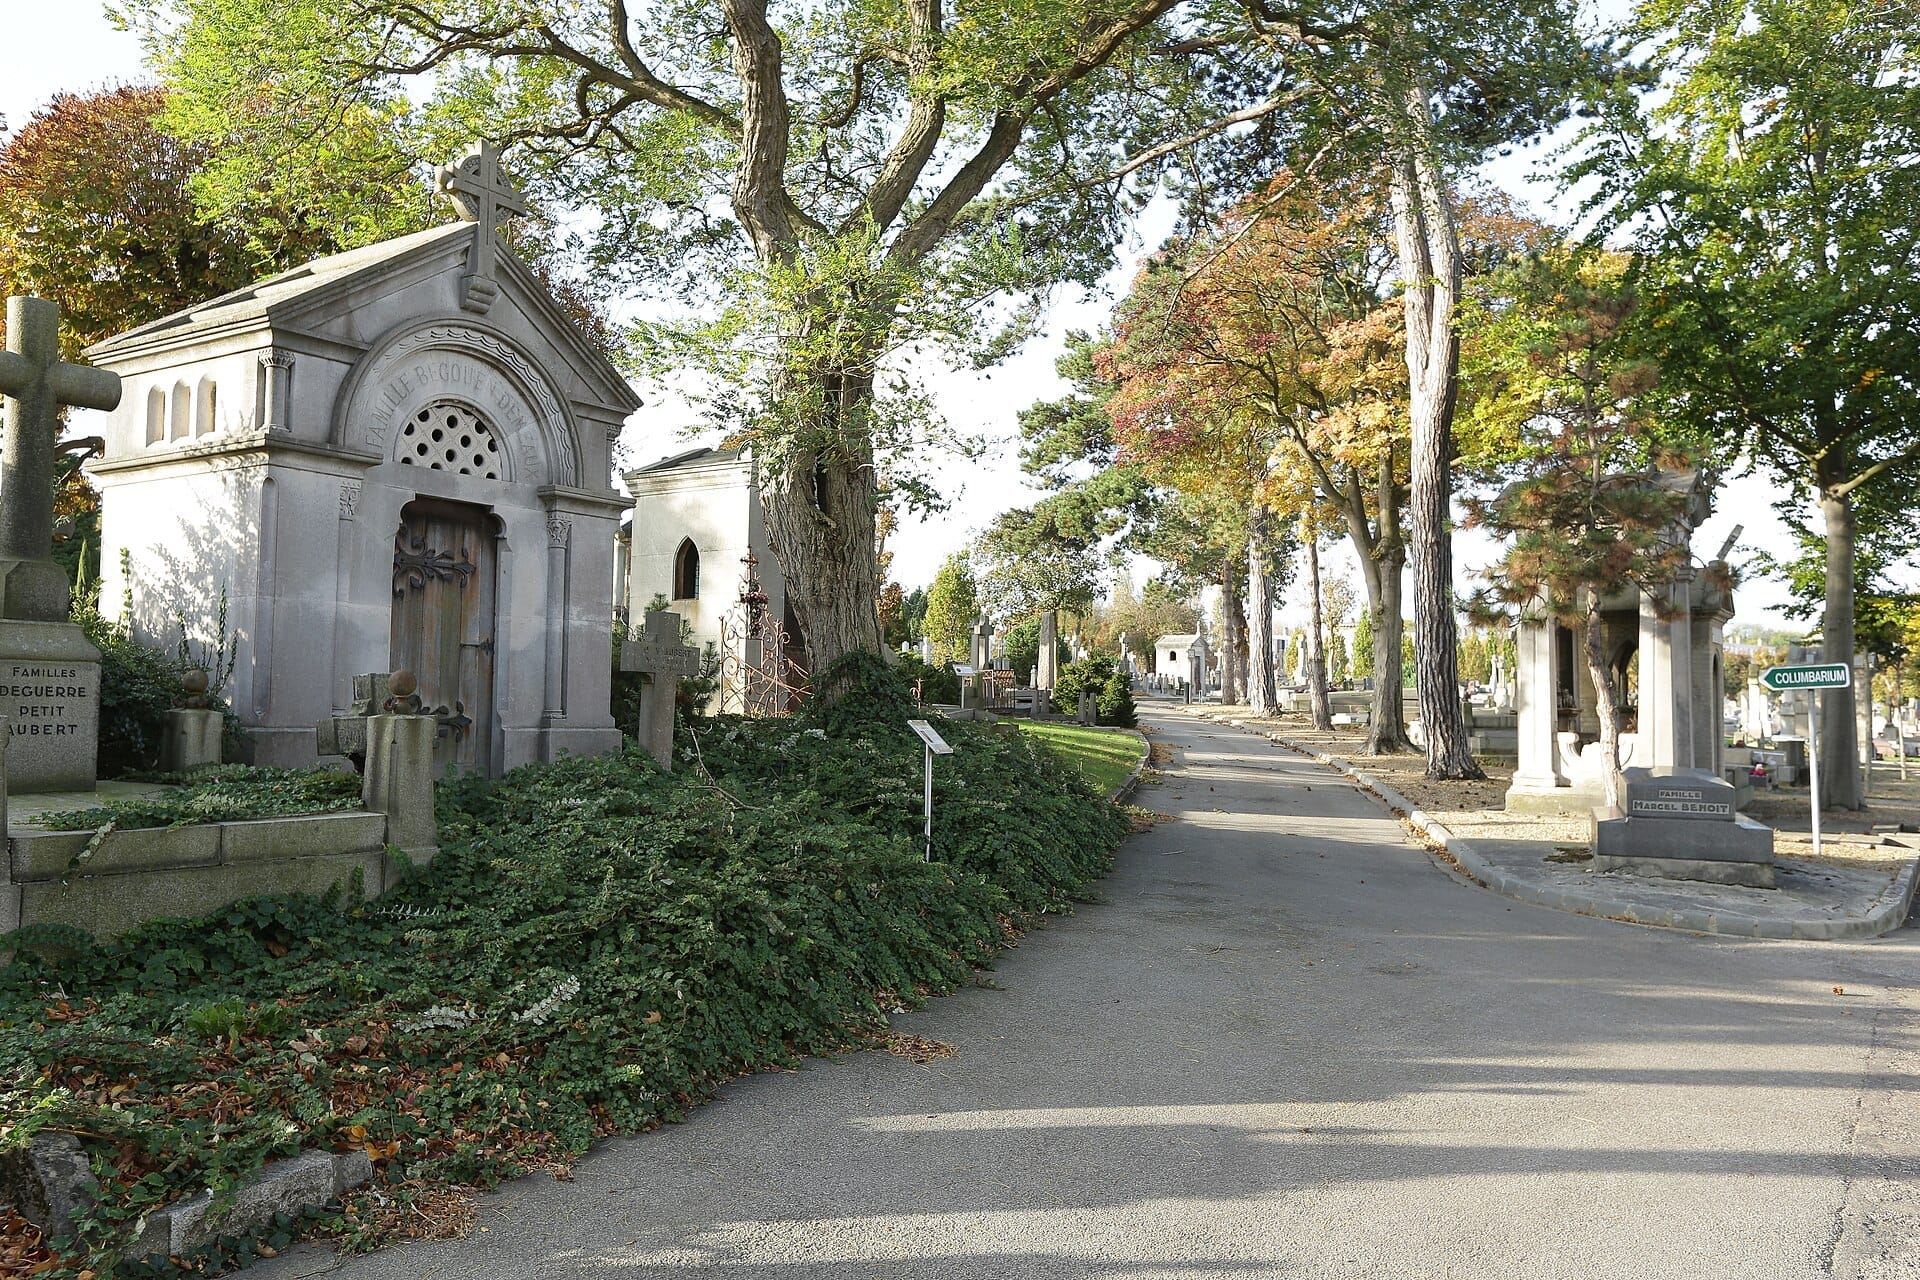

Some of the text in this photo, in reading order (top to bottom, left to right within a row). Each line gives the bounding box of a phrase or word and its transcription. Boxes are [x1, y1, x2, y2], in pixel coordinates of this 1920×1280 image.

[365, 371, 416, 450] FAMILLE
[12, 666, 77, 678] FAMILLES
[1775, 669, 1846, 684] COLUMBARIUM
[0, 685, 87, 698] DEGUERRE
[19, 705, 65, 717] PETIT
[1660, 791, 1701, 799] FAMILLE
[1633, 800, 1728, 814] MARCEL BENOIT
